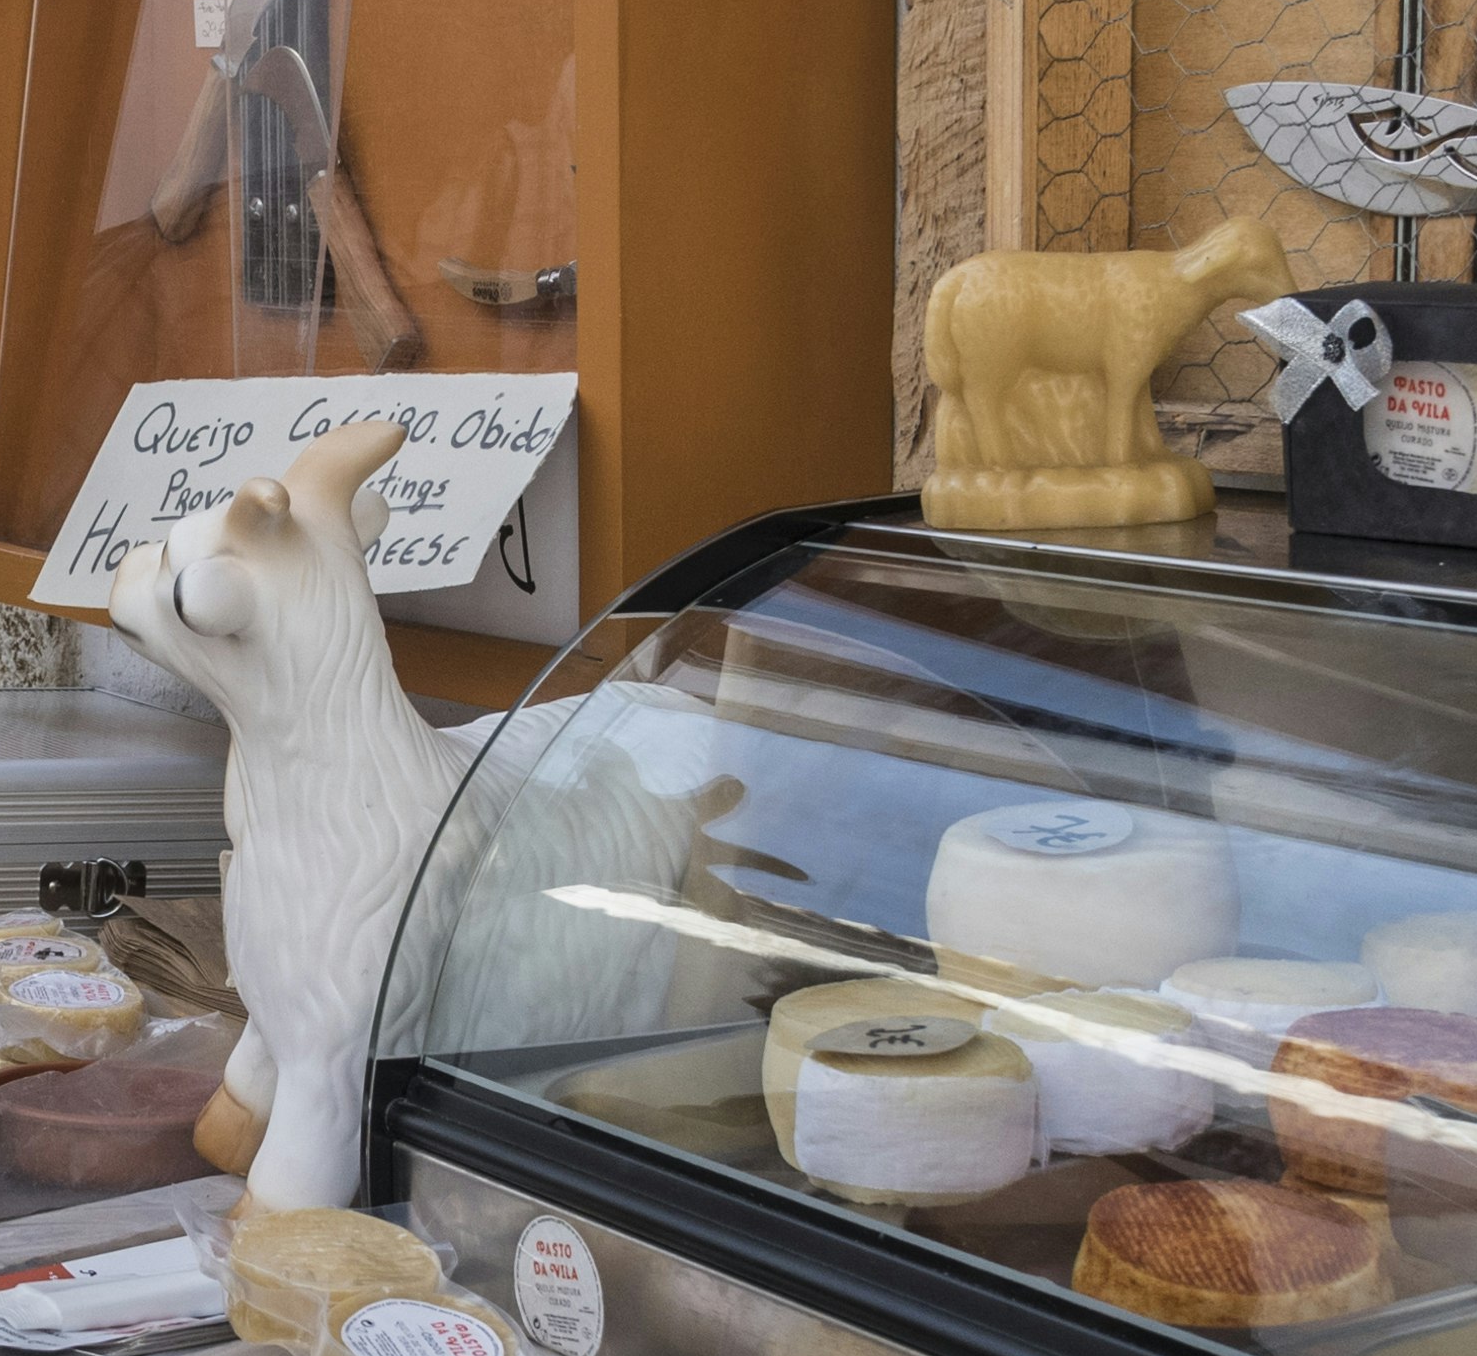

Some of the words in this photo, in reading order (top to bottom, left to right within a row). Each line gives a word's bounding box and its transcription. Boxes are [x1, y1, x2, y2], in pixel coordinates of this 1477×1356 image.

[1393, 376, 1446, 397] PASTO
[1387, 396, 1407, 414] DA
[1411, 401, 1451, 421] VILA
[1385, 419, 1414, 431] QUEIJO
[1417, 423, 1451, 437] MISTURA
[1400, 435, 1434, 447] CURADO
[535, 1240, 572, 1259] PASTO
[533, 1260, 548, 1277] DA
[549, 1262, 579, 1282] VILA
[430, 1321, 449, 1338] DA
